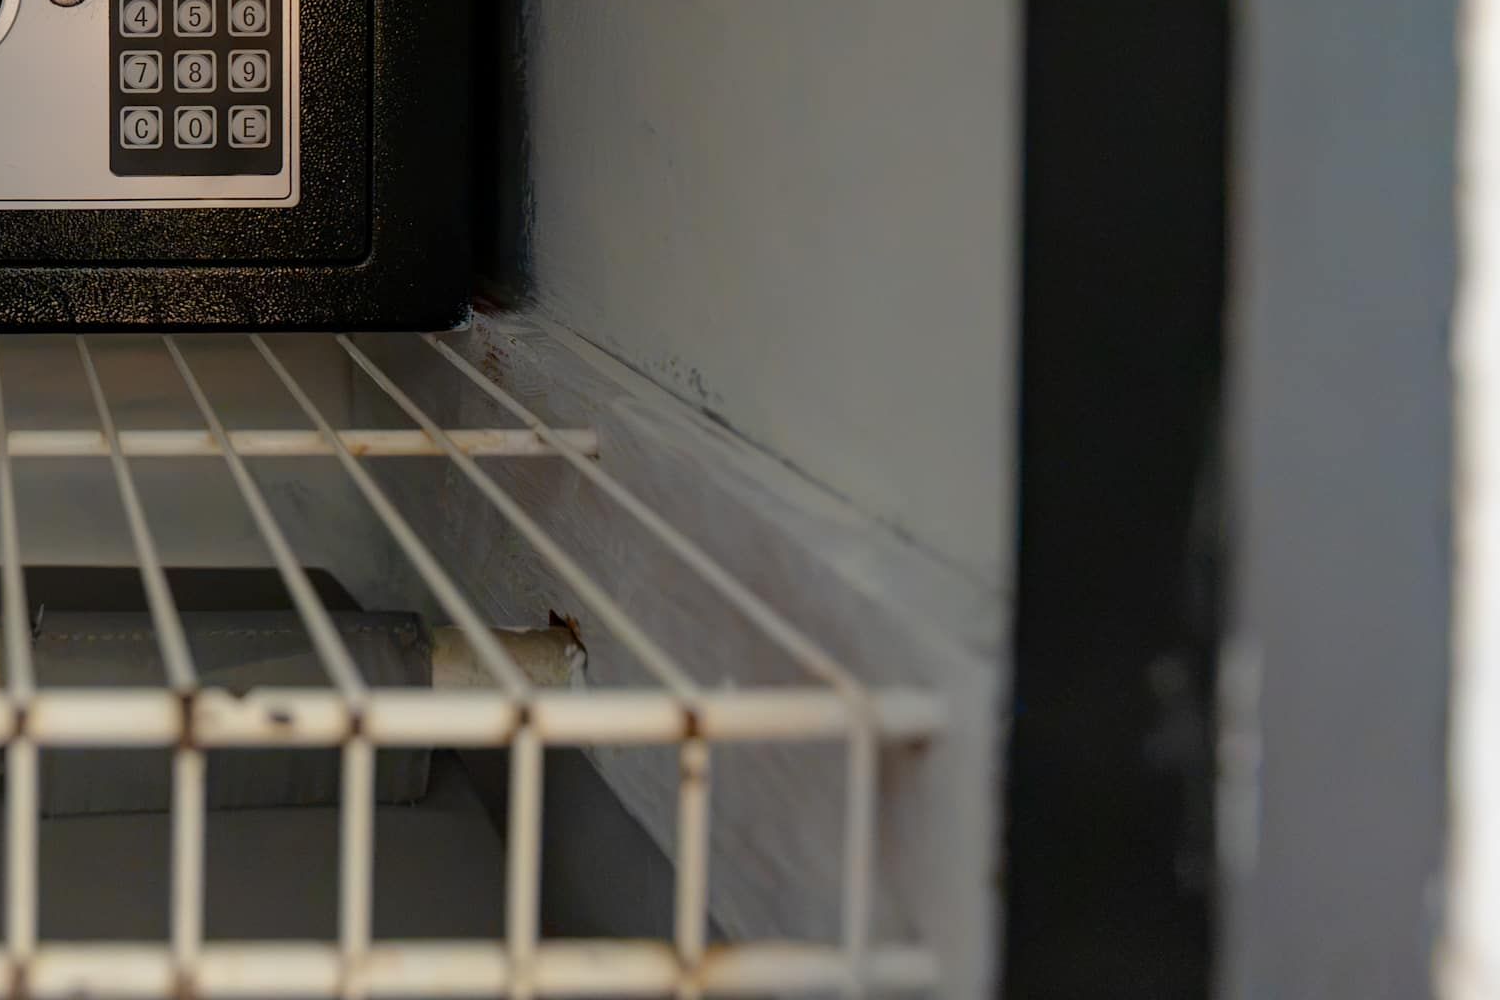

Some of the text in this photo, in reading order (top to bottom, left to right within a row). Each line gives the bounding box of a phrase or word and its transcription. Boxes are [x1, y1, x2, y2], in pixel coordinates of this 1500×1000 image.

[134, 5, 256, 27] 4 5 6
[134, 61, 256, 83] 7 8 9
[134, 118, 149, 139] C
[243, 117, 256, 138] E
